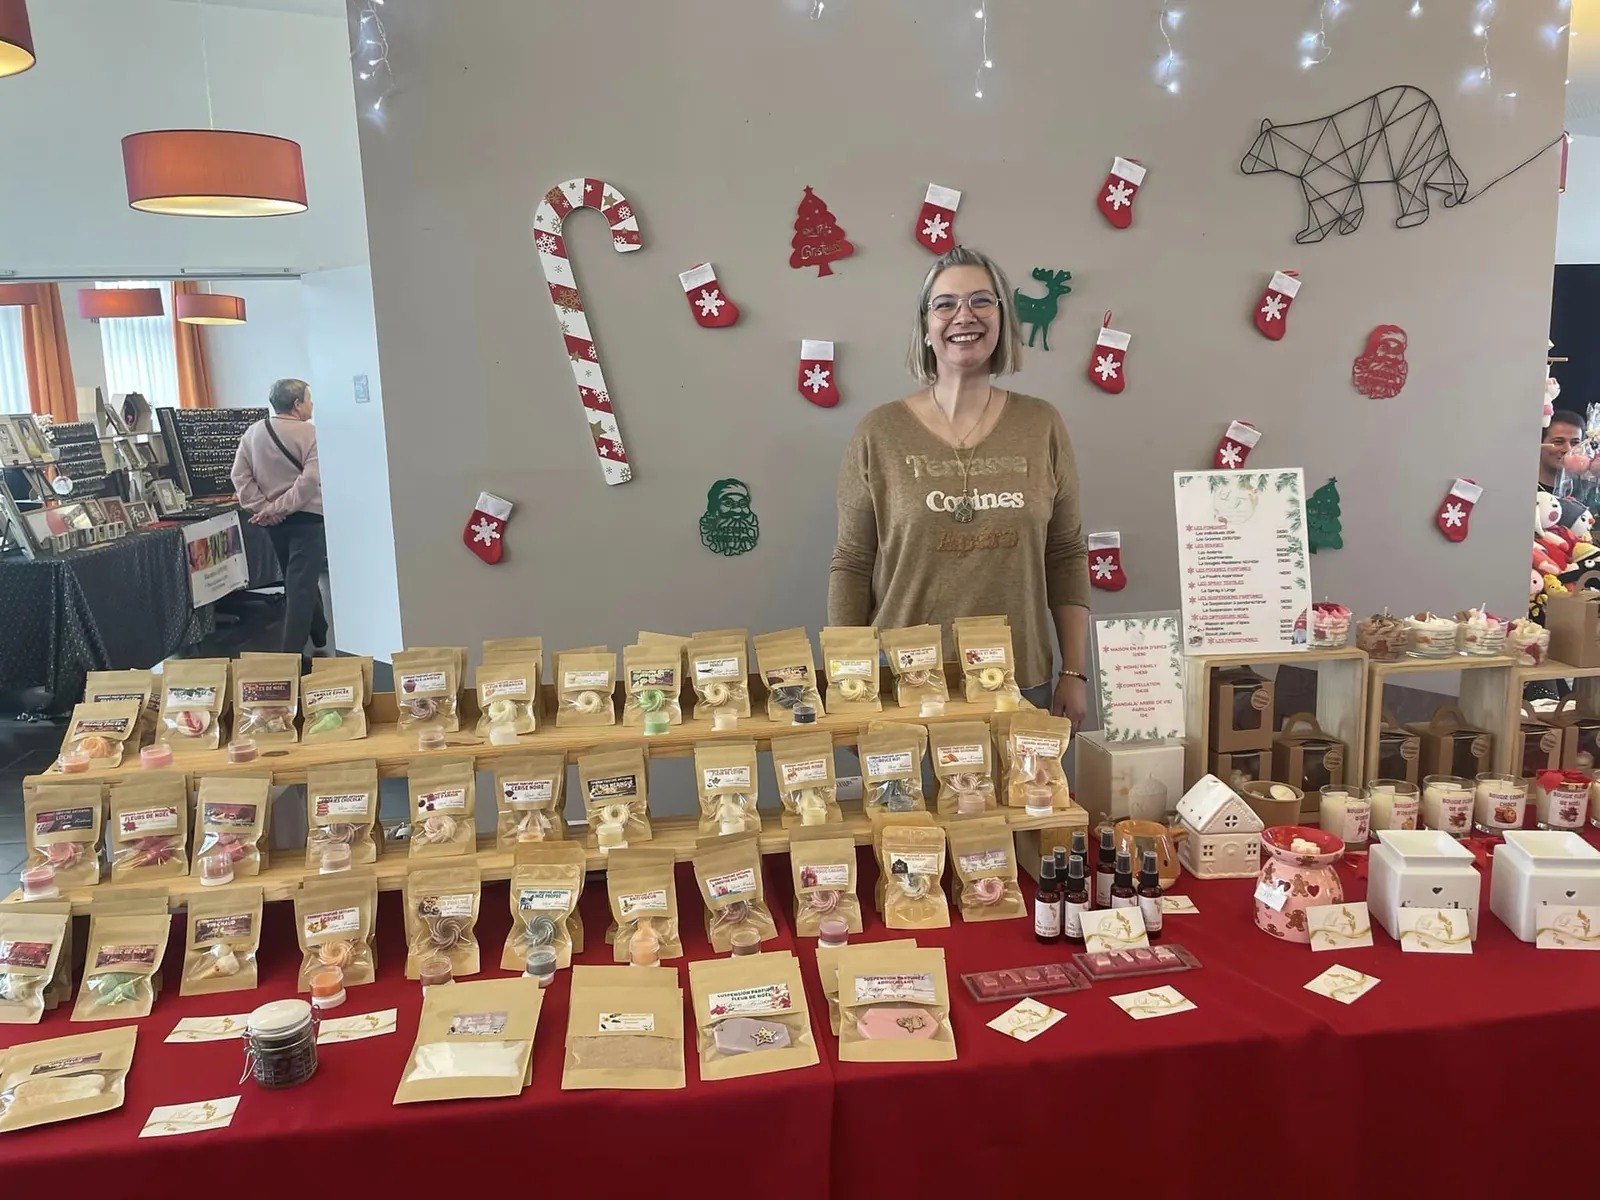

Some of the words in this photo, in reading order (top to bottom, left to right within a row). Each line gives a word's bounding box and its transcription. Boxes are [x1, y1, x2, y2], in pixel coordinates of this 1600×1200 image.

[926, 488, 1025, 513] Coines
[55, 814, 73, 822] LITCHI
[320, 914, 345, 923] AGRUMES
[717, 990, 751, 999] SUSPENSION
